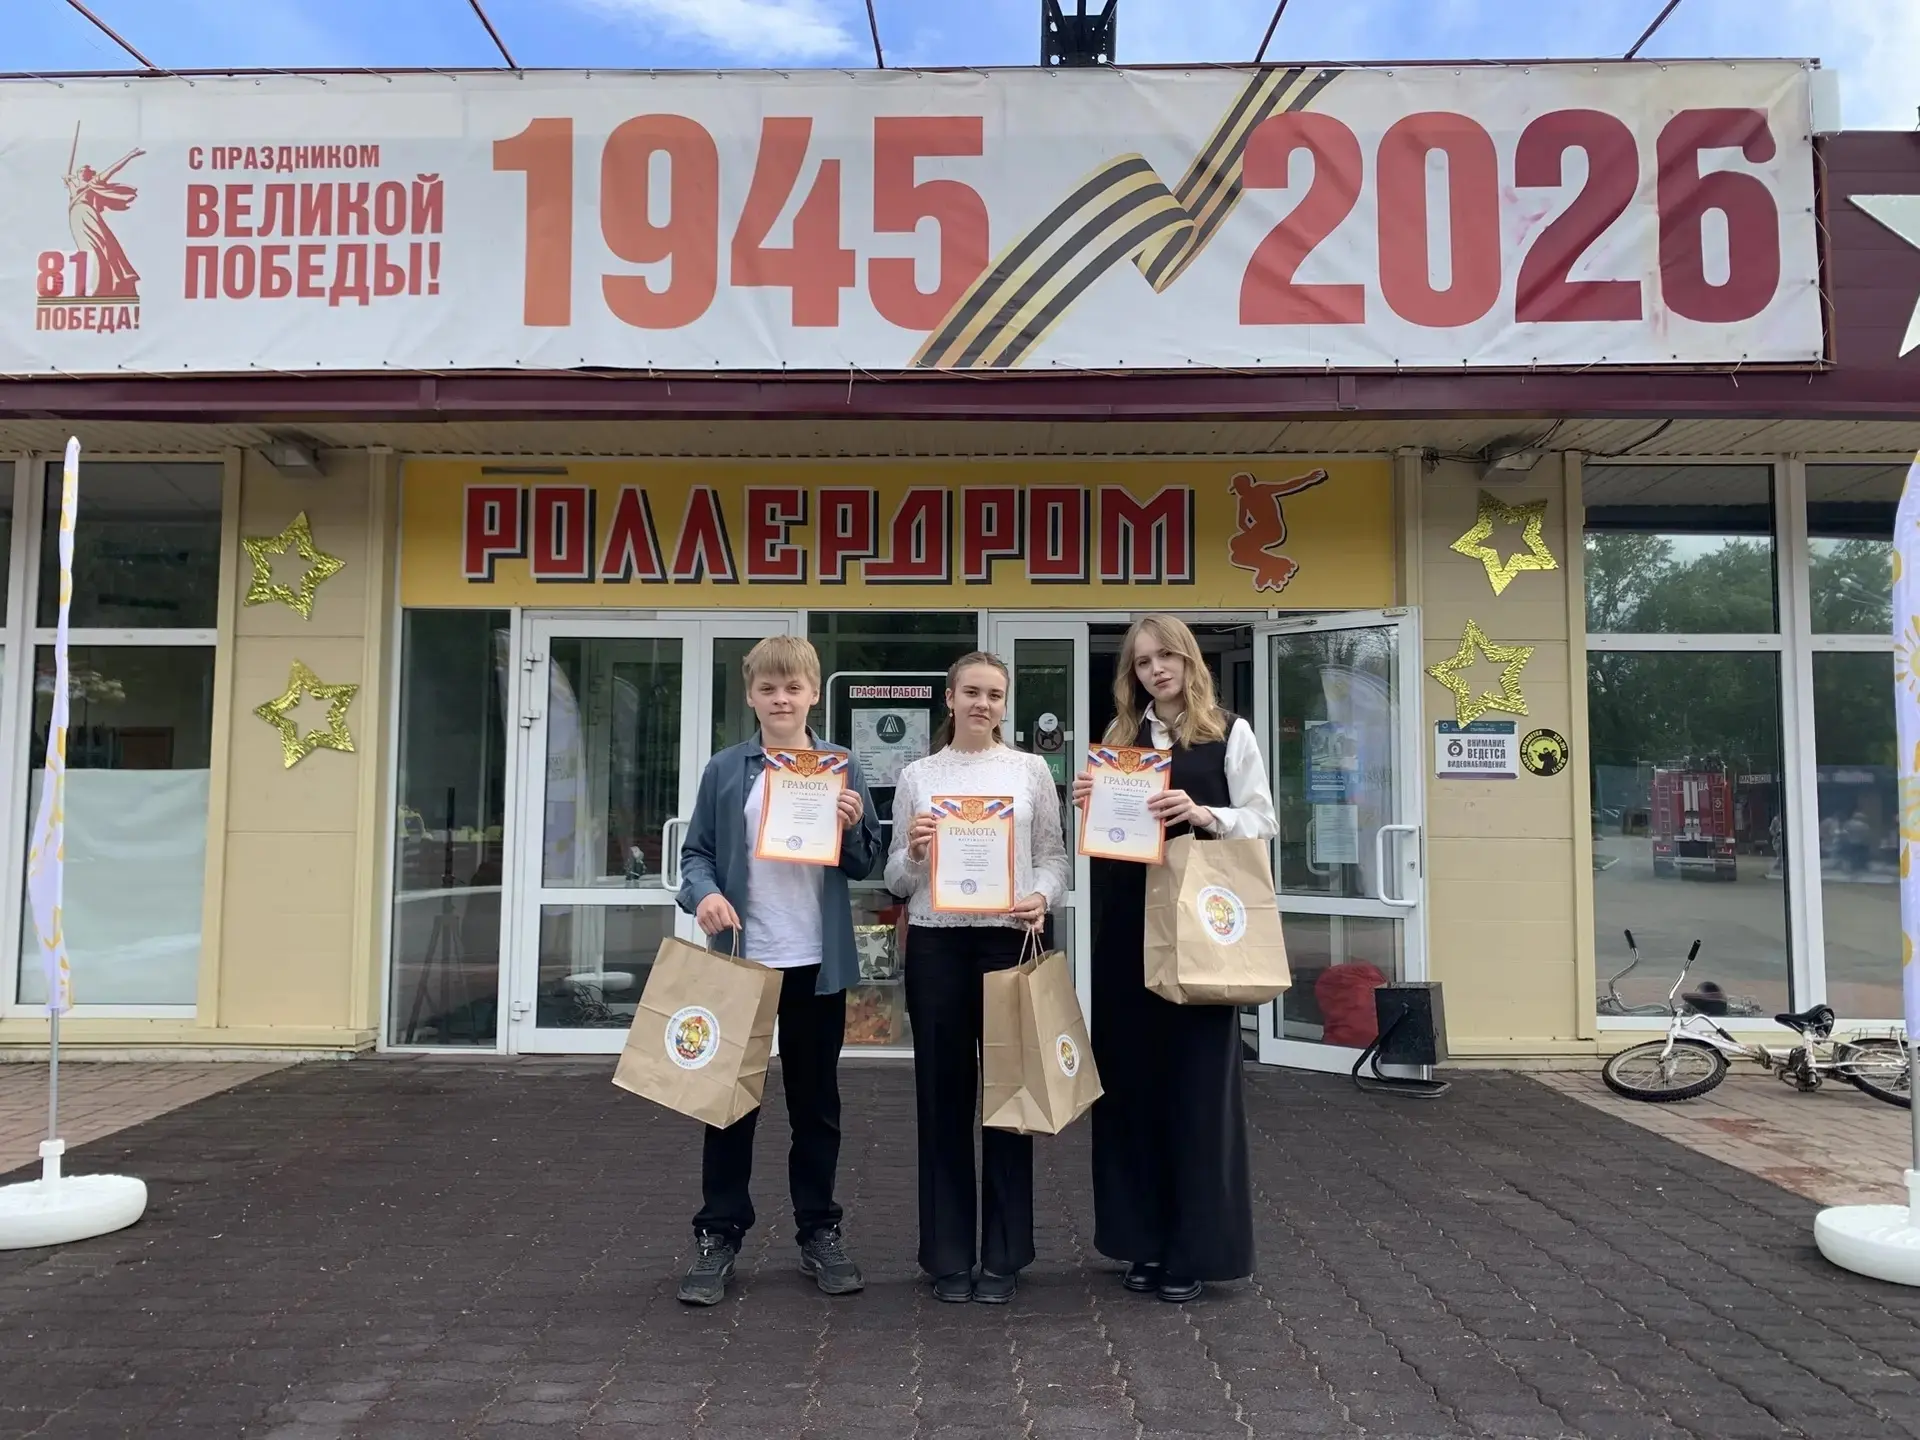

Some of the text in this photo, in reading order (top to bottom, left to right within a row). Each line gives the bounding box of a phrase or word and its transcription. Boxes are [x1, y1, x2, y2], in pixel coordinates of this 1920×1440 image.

[188, 145, 380, 174] С ПРАЗДНИКОМ
[186, 173, 444, 238] ВЕЛИКОЙ
[1239, 108, 1780, 328] 2026
[492, 113, 990, 331] 1945
[36, 250, 88, 297] 81
[184, 241, 441, 307] ПОБЕДЫ!
[36, 305, 140, 334] ПОБЕДА!
[463, 484, 1193, 584] РОЛЛЕРДРОМ
[850, 686, 932, 698] ГРАФИК РАБОТЫ
[1467, 738, 1506, 748] ВНИМАНИЕ
[1467, 748, 1506, 760] ВЕДЕТСЯ
[1447, 760, 1507, 769] ВИДЕОНАБЛЮДЕНИЕ
[782, 779, 829, 791] ГРАМОТА
[1103, 775, 1151, 788] ГРАМОТА
[948, 826, 997, 837] ГРАМОТА
